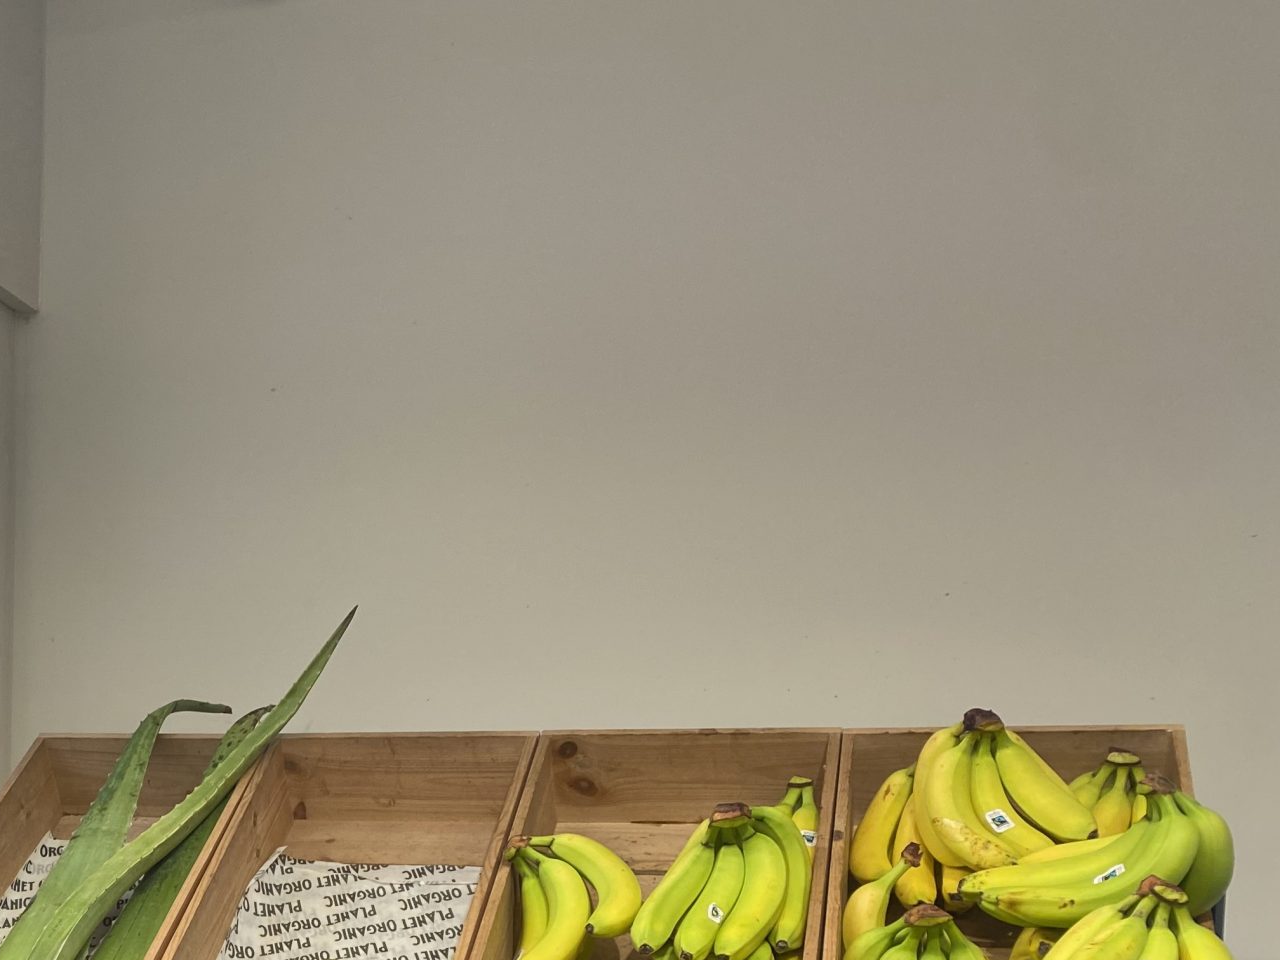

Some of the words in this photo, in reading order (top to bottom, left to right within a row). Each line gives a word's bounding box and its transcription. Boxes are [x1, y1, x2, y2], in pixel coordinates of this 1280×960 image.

[323, 886, 387, 908] ORGANIC
[398, 887, 462, 911] ORGANIC
[253, 900, 302, 918] PLANET
[326, 904, 377, 926] PLANET
[402, 908, 455, 931] PLANET
[258, 917, 321, 938] ORGANIC
[333, 919, 397, 942] ORGANIC
[410, 924, 464, 946] RGANIC
[259, 937, 311, 957] PLANET
[334, 941, 388, 960] PLANET
